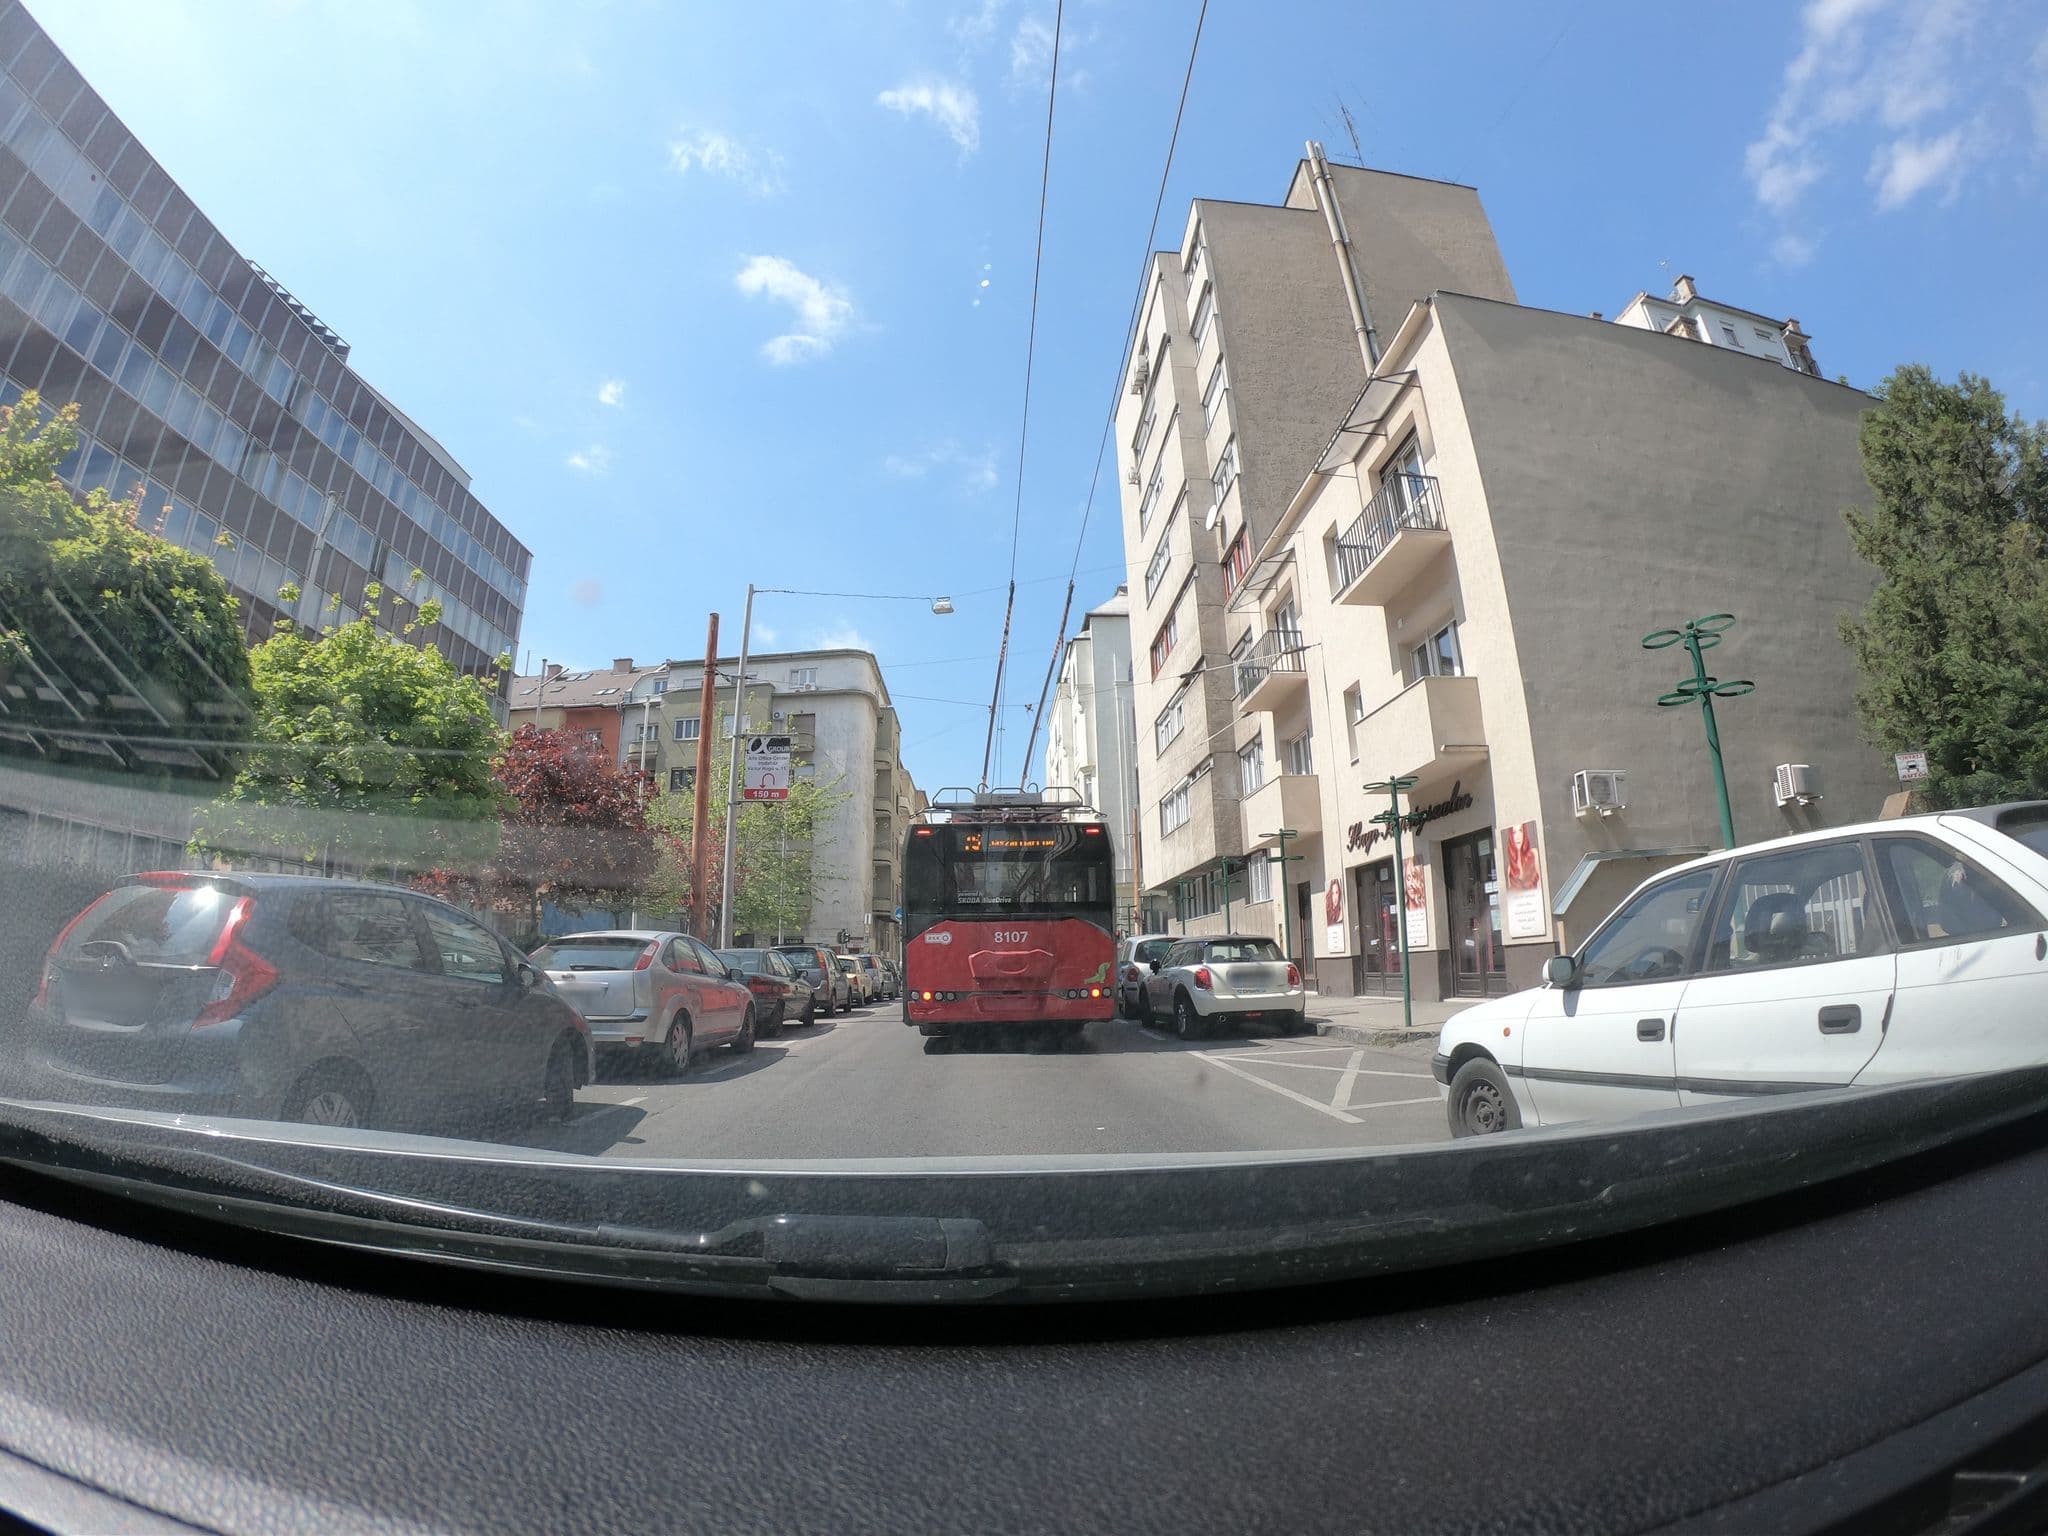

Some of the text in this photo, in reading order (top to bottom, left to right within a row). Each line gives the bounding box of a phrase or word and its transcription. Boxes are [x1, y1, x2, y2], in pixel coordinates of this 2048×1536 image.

[752, 790, 780, 799] 150 m
[994, 931, 1029, 944] 8107
